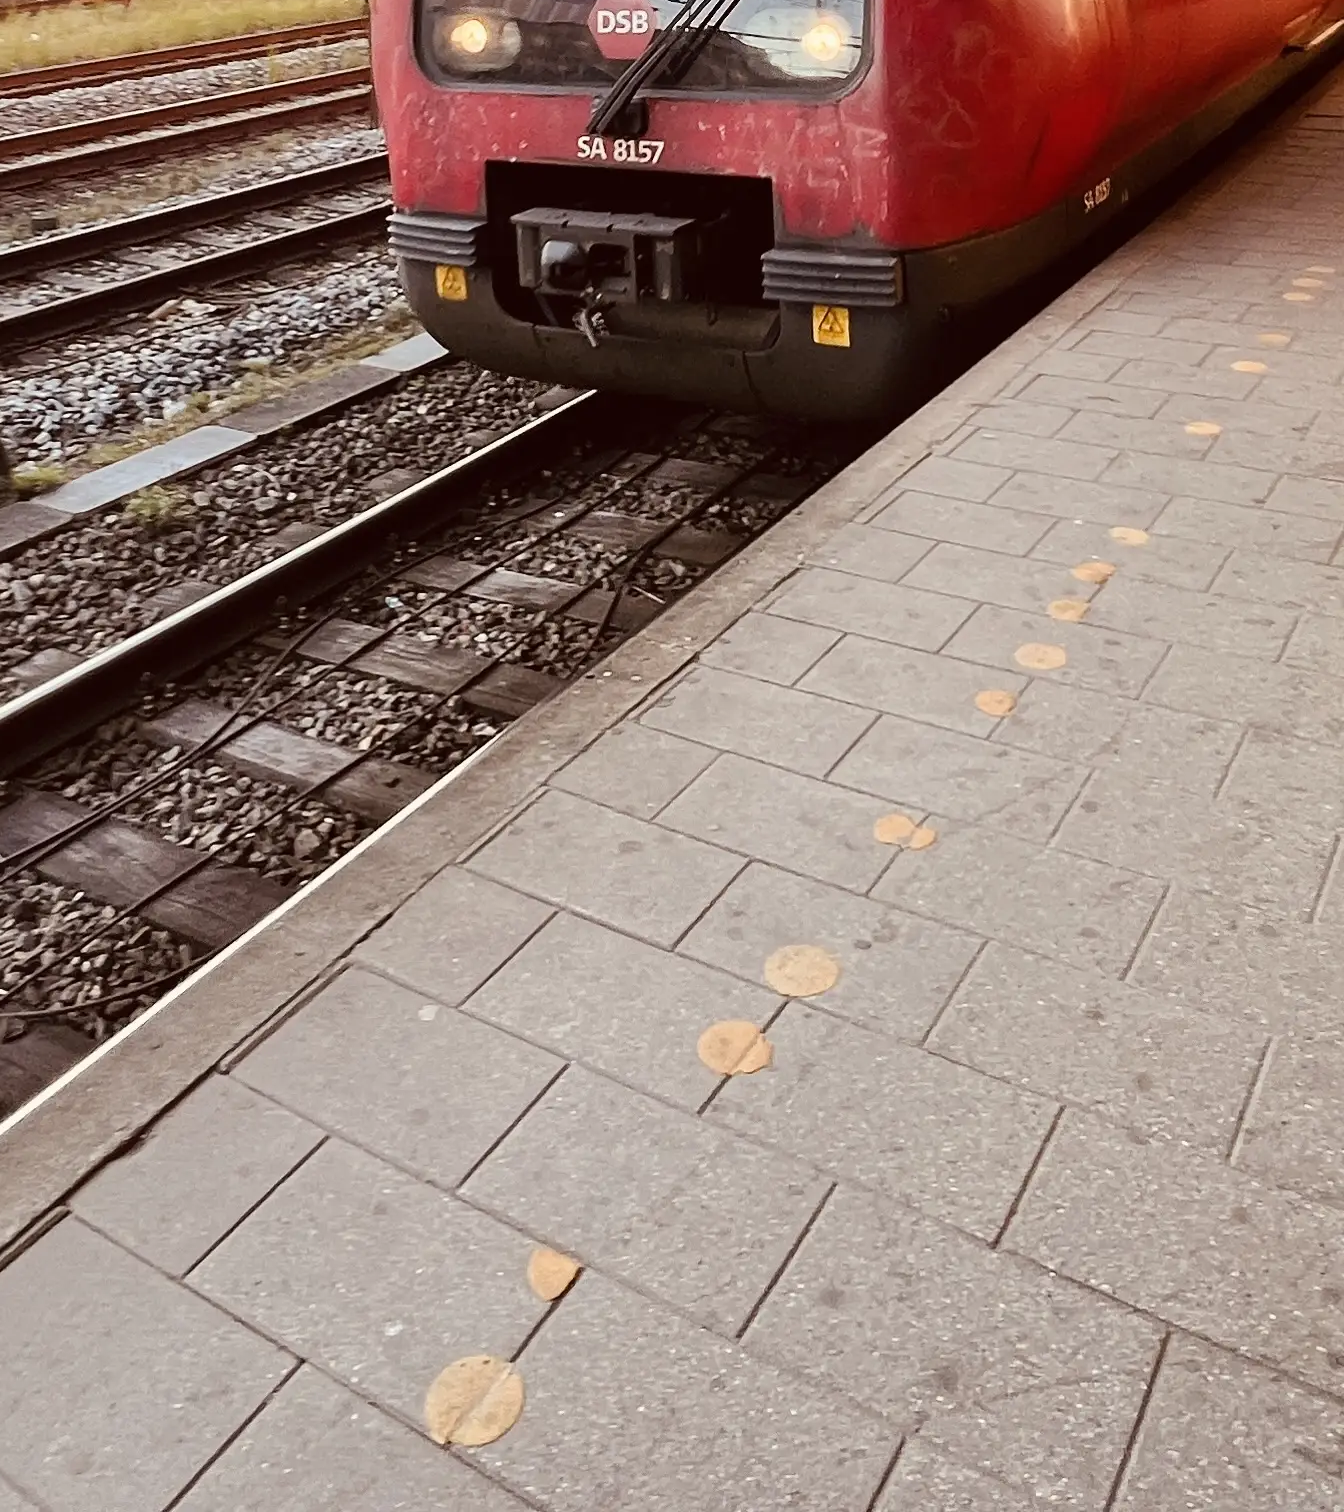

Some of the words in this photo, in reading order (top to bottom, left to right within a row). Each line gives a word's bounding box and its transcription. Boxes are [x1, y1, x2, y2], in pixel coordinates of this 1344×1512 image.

[596, 10, 649, 34] DSB
[577, 135, 608, 161] SA
[613, 138, 665, 165] 8157
